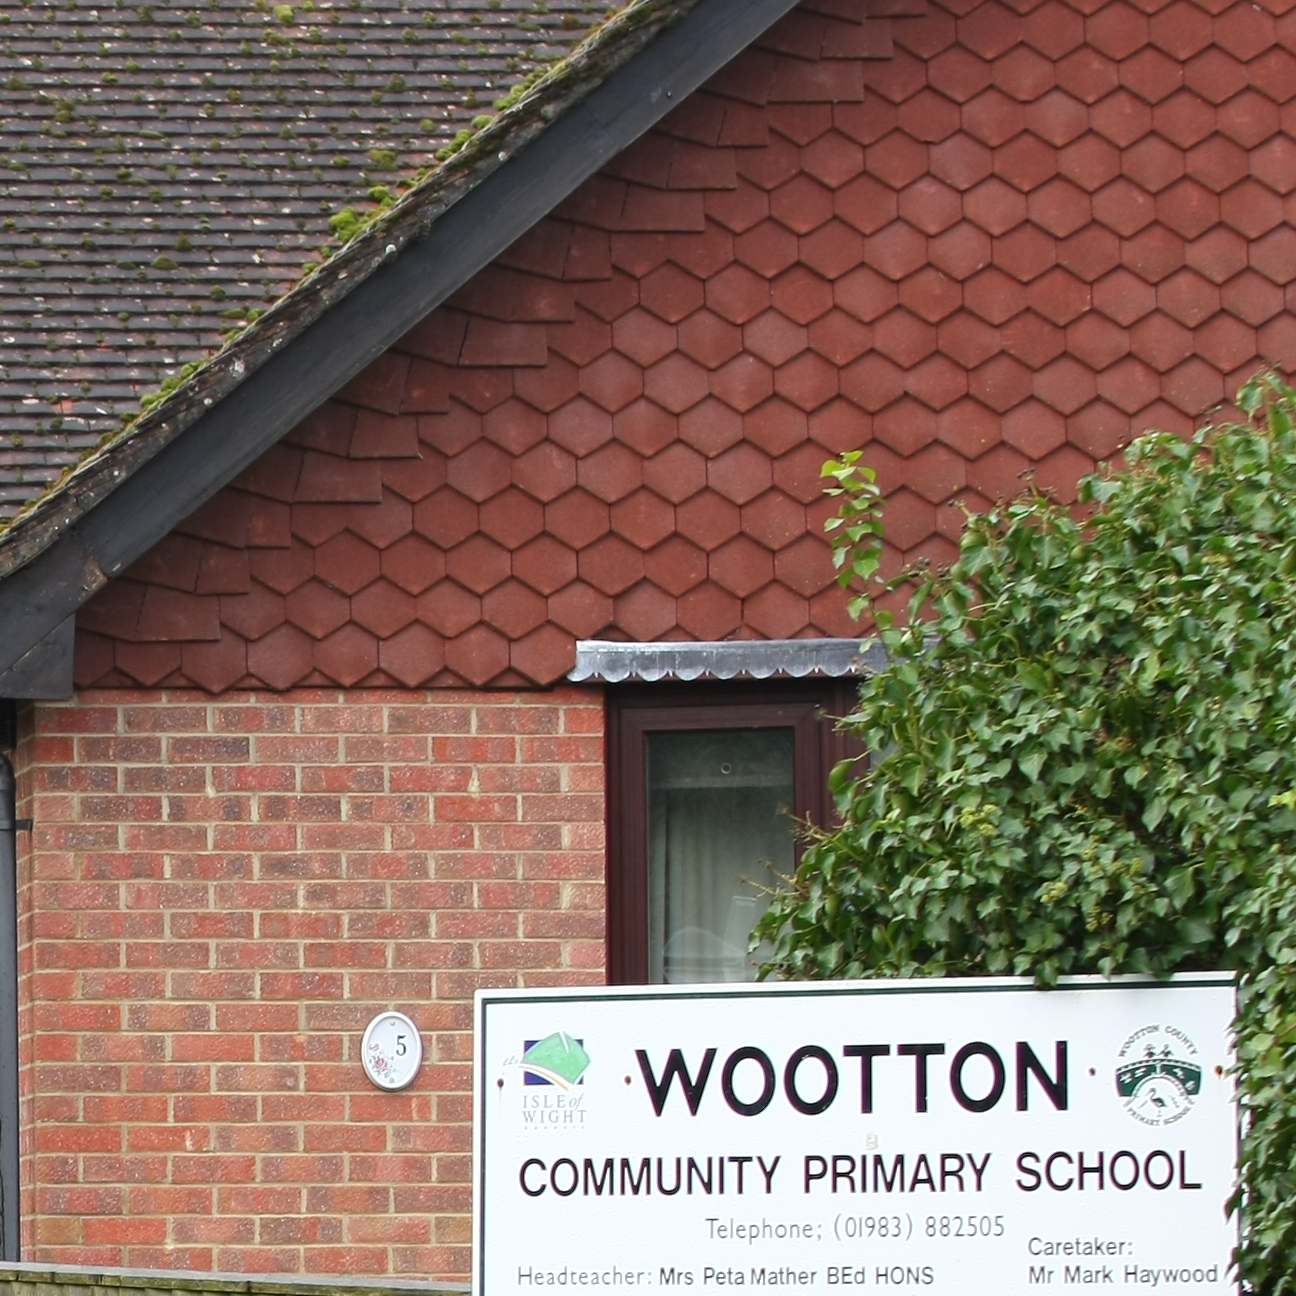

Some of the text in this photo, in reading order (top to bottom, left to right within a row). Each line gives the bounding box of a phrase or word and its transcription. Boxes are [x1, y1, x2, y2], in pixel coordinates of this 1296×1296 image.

[396, 1034, 407, 1057] 5
[635, 1039, 1069, 1118] WOOTTON
[522, 1092, 586, 1112] ISLE of
[522, 1109, 587, 1124] WIGHT
[518, 1149, 1203, 1198] COMMUNITY PRIMARY SCHOOL
[834, 1212, 913, 1241] (01983)
[925, 1215, 1005, 1238] 882505
[1028, 1237, 1133, 1255] Caretaker:
[518, 1266, 934, 1286] Headteacher: Mrs Peta Mather BEd HONS
[1029, 1264, 1218, 1287] Mr Mark Haywood
